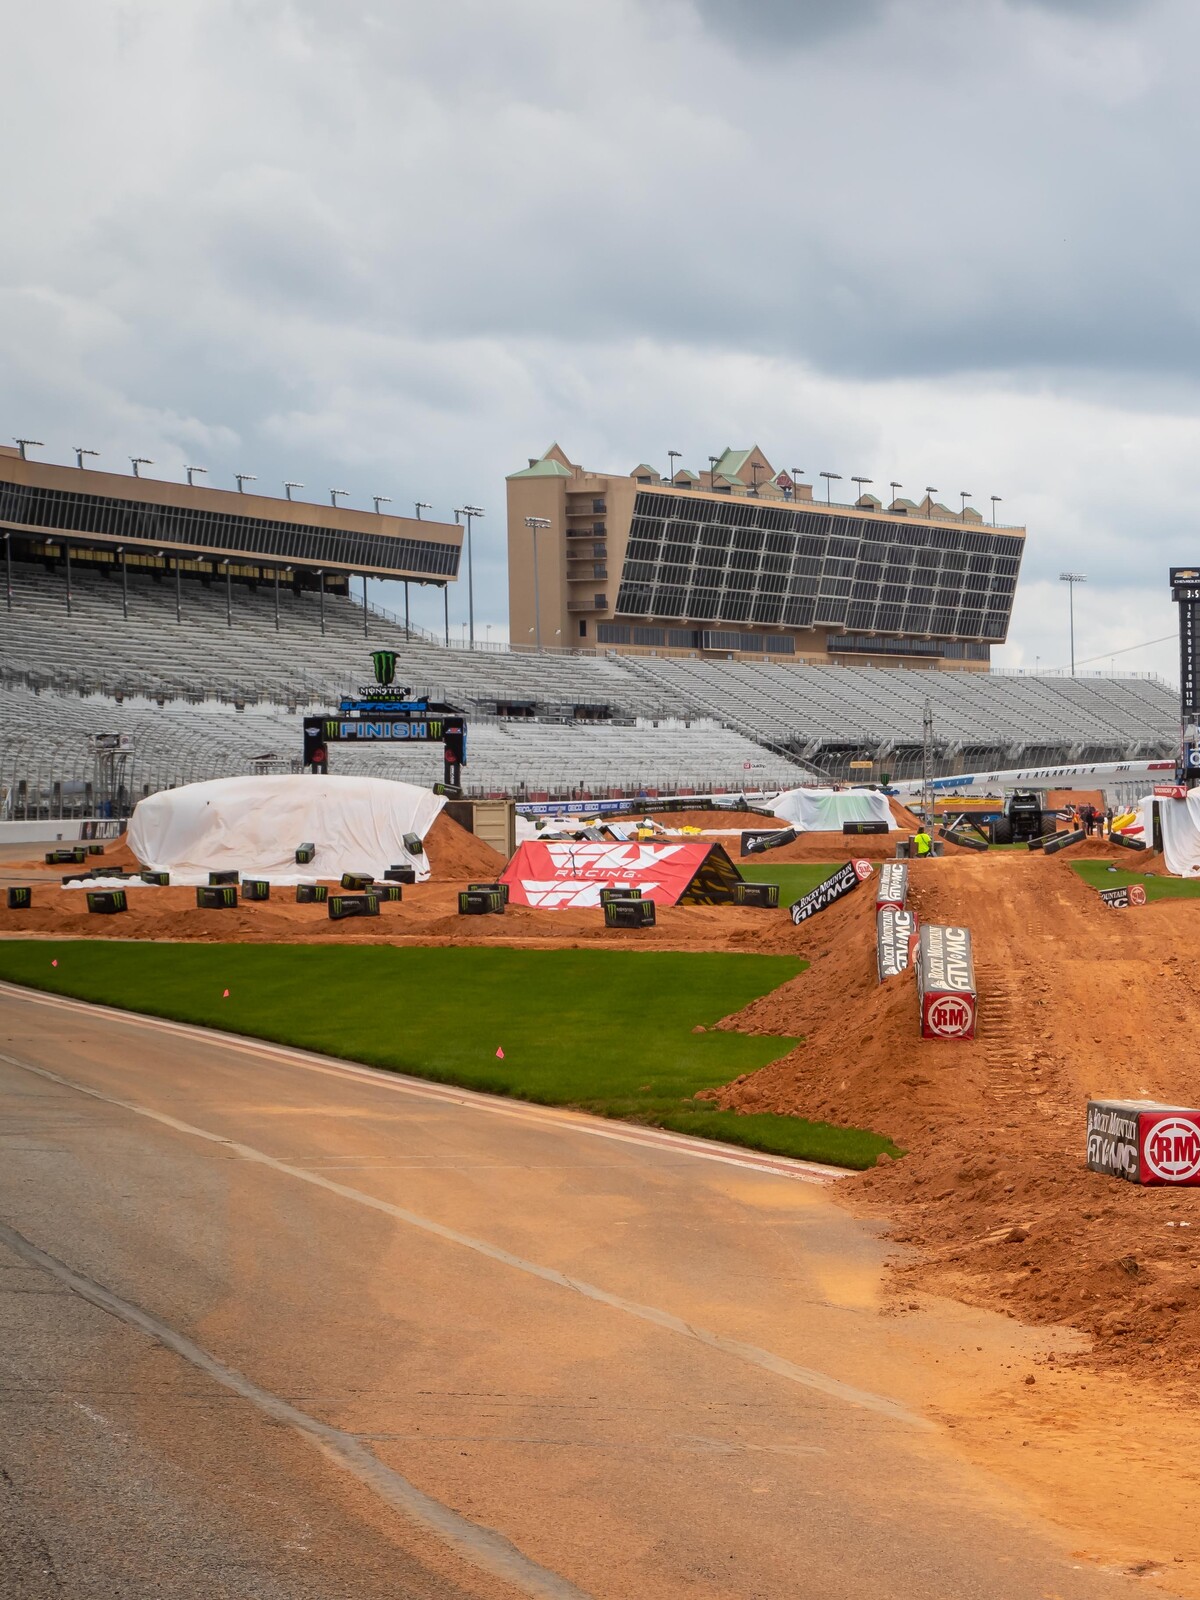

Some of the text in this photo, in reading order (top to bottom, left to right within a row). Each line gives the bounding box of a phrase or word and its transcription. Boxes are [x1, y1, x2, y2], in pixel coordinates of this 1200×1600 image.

[360, 687, 406, 695] MONSTER
[339, 721, 428, 739] FINISH
[1033, 768, 1077, 778] ATLANTA
[584, 803, 599, 811] GEICO
[546, 843, 686, 869] FLY
[554, 869, 638, 878] RACING
[800, 863, 852, 907] ROCKY MOUNTAIN
[1101, 889, 1127, 900] OUNTAIN
[882, 911, 895, 966] ROCKY MOUNTAIN
[927, 926, 945, 980] ROCKY MOUNTAIN
[937, 1008, 963, 1026] RM
[1094, 1108, 1110, 1133] ROCKY
[1156, 1136, 1195, 1163] RM
